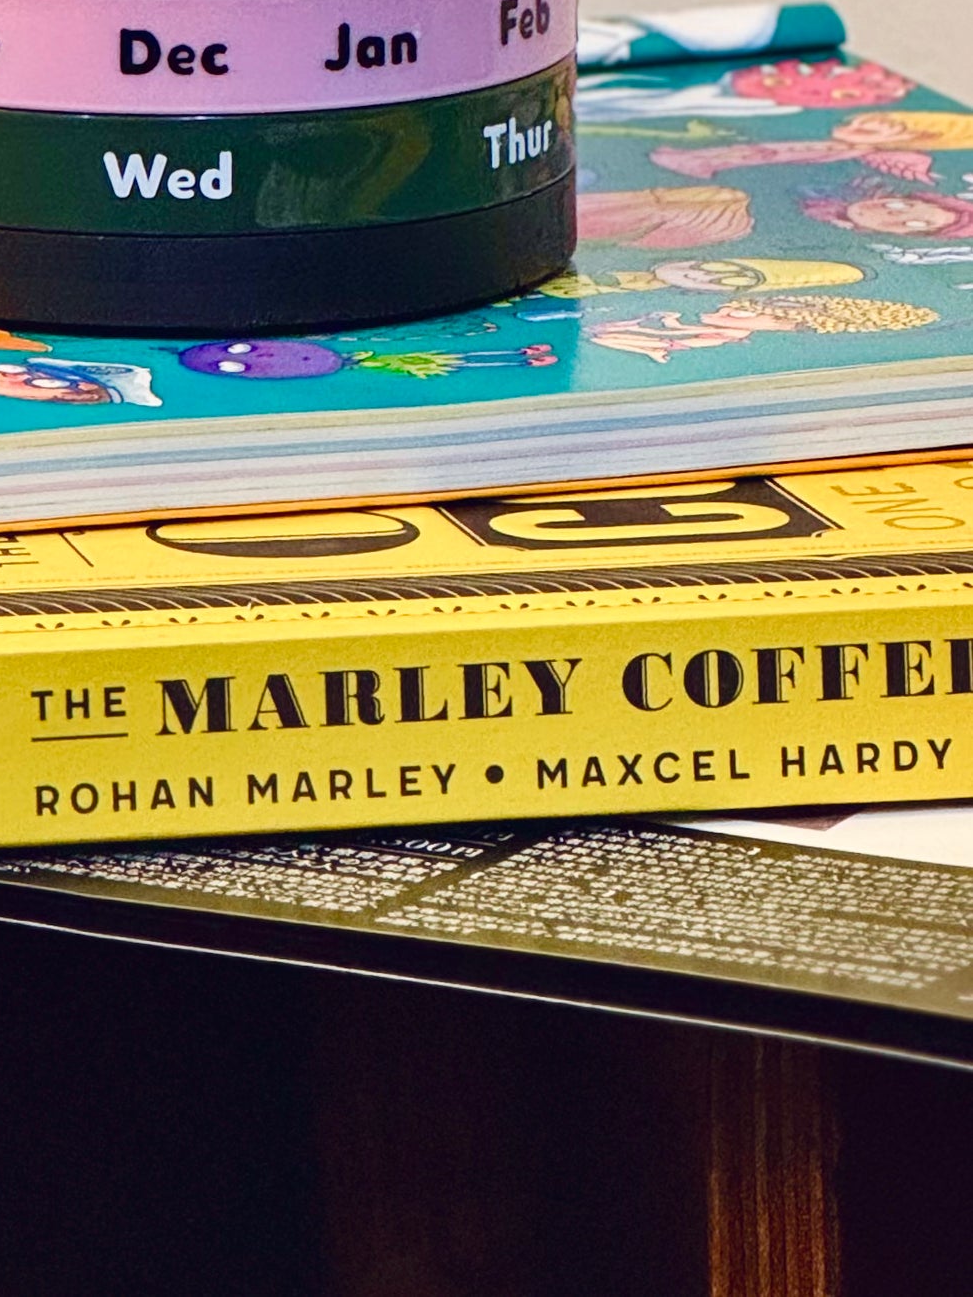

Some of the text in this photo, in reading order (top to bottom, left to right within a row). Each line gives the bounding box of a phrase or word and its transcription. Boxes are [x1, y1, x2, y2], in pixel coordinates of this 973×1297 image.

[119, 27, 230, 76] Dec
[324, 22, 418, 72] Jan
[103, 150, 233, 200] Wed
[483, 116, 553, 169] Thur
[30, 686, 127, 722] THE
[156, 658, 583, 736] MARLEY
[35, 738, 952, 817] ROHAN MARLEY MAXCEL HARDY
